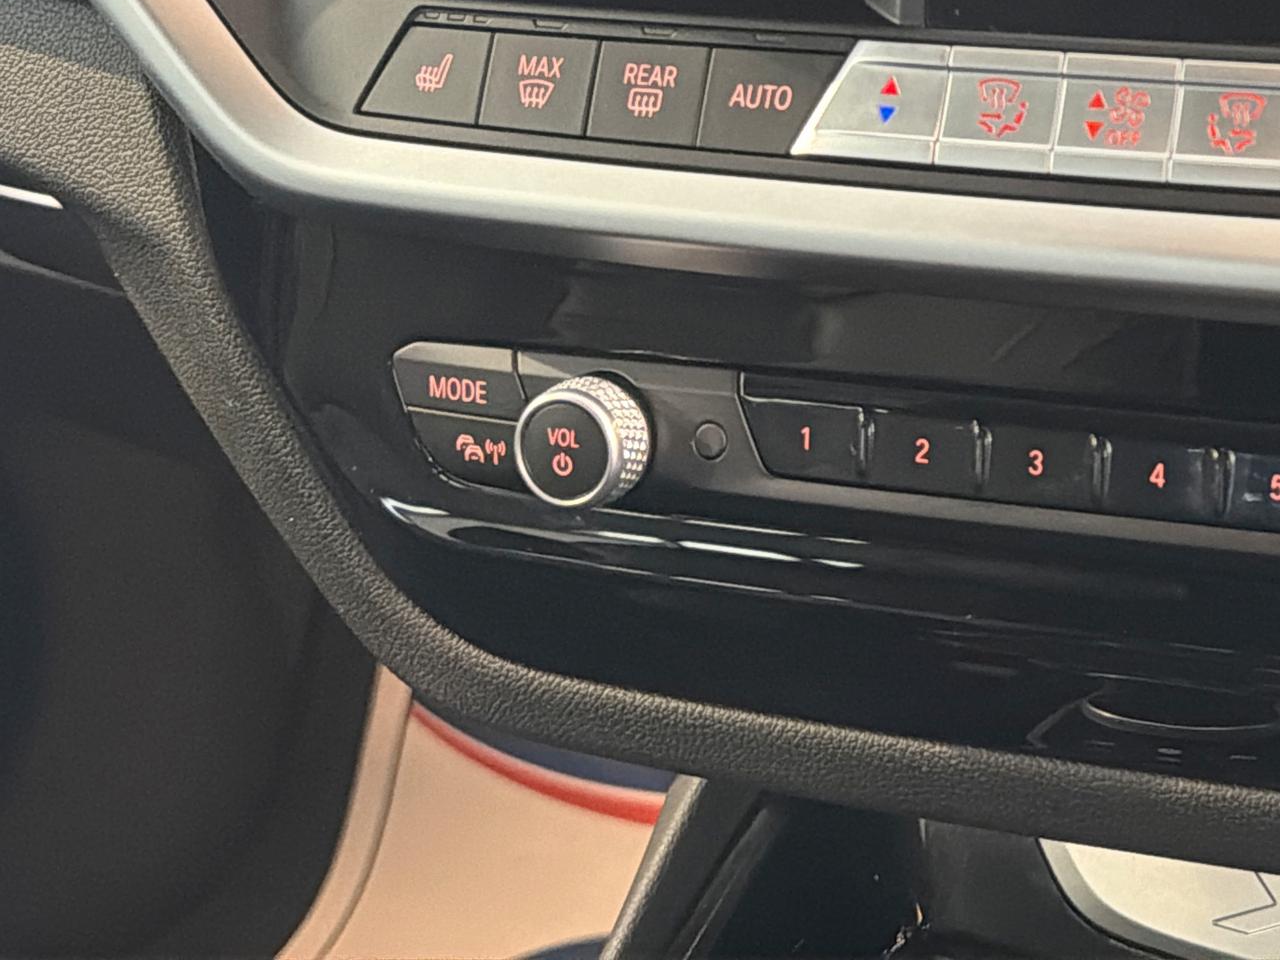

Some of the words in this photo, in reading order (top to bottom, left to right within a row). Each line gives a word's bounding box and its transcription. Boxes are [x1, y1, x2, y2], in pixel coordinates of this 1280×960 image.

[517, 54, 565, 79] MAX
[623, 63, 678, 87] REAR
[728, 83, 793, 111] AUTO
[428, 375, 488, 405] MODE
[546, 427, 580, 449] VOL
[800, 426, 811, 451] 1
[914, 438, 930, 465] 2
[1027, 449, 1044, 477] 3
[1148, 462, 1166, 489] 4
